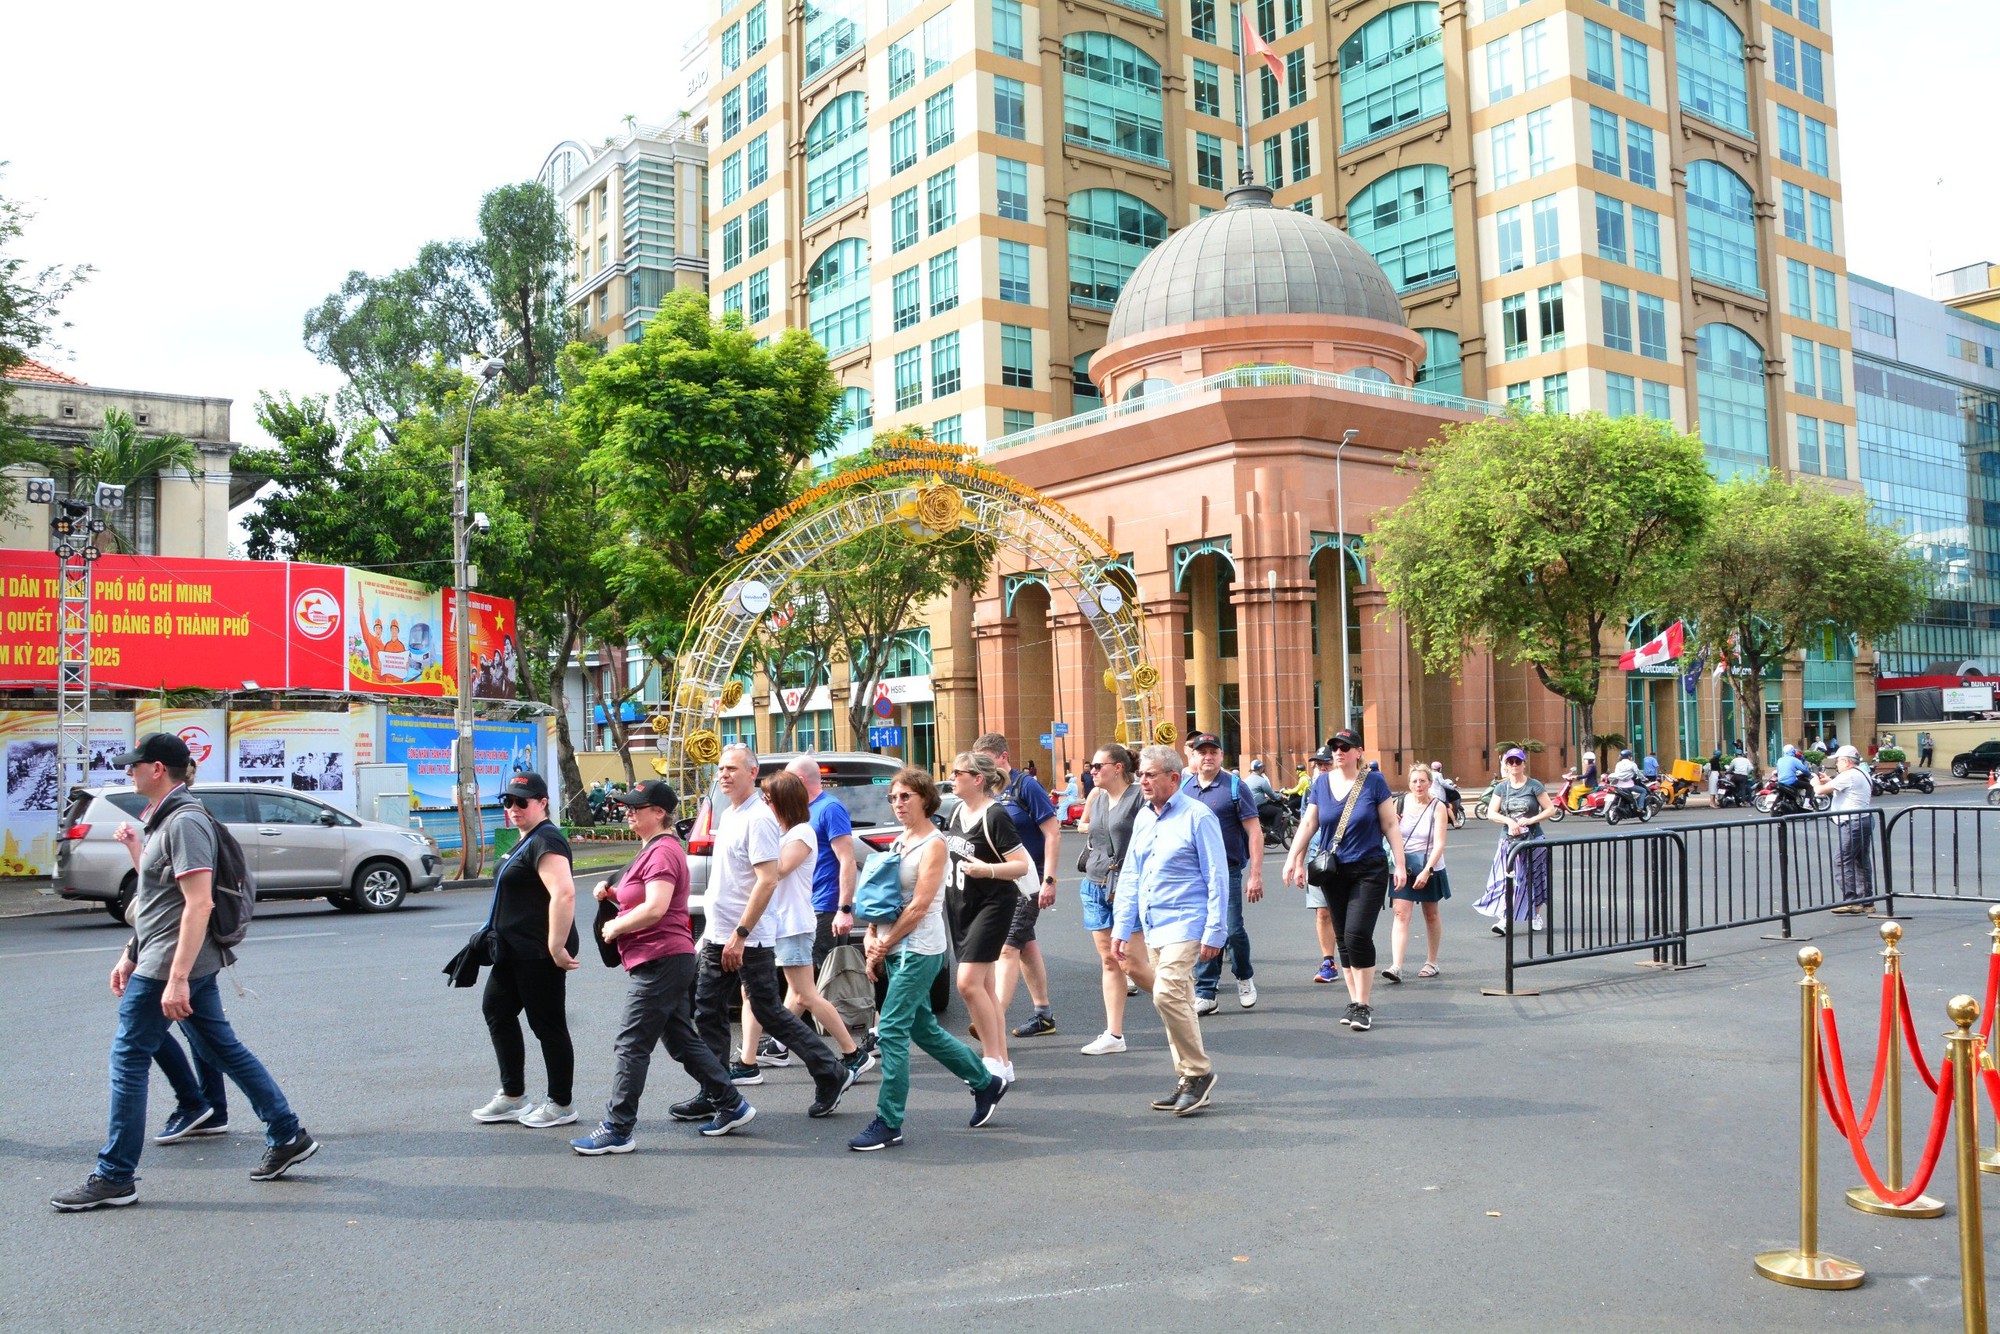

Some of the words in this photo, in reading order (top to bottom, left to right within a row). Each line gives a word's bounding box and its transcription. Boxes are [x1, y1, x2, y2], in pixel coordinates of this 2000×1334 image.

[734, 523, 765, 555] NGÀY
[788, 482, 829, 514] PHÓNG
[829, 467, 860, 491] MIỀN
[886, 454, 925, 473] THỐNG
[924, 456, 954, 472] NHẤT
[9, 574, 40, 598] DÂN
[95, 576, 123, 601] PHỐ
[127, 577, 146, 602] HỒ
[150, 580, 172, 602] CHÍ
[176, 584, 212, 603] MINH
[7, 606, 53, 633] QUYẾT
[112, 609, 150, 634] ĐẢNG
[154, 612, 173, 639] BỘ
[176, 613, 220, 635] THÀNH
[223, 611, 250, 636] PHỐ
[14, 641, 33, 665] KỲ
[89, 647, 120, 667] 2025
[891, 684, 907, 694] HSBC
